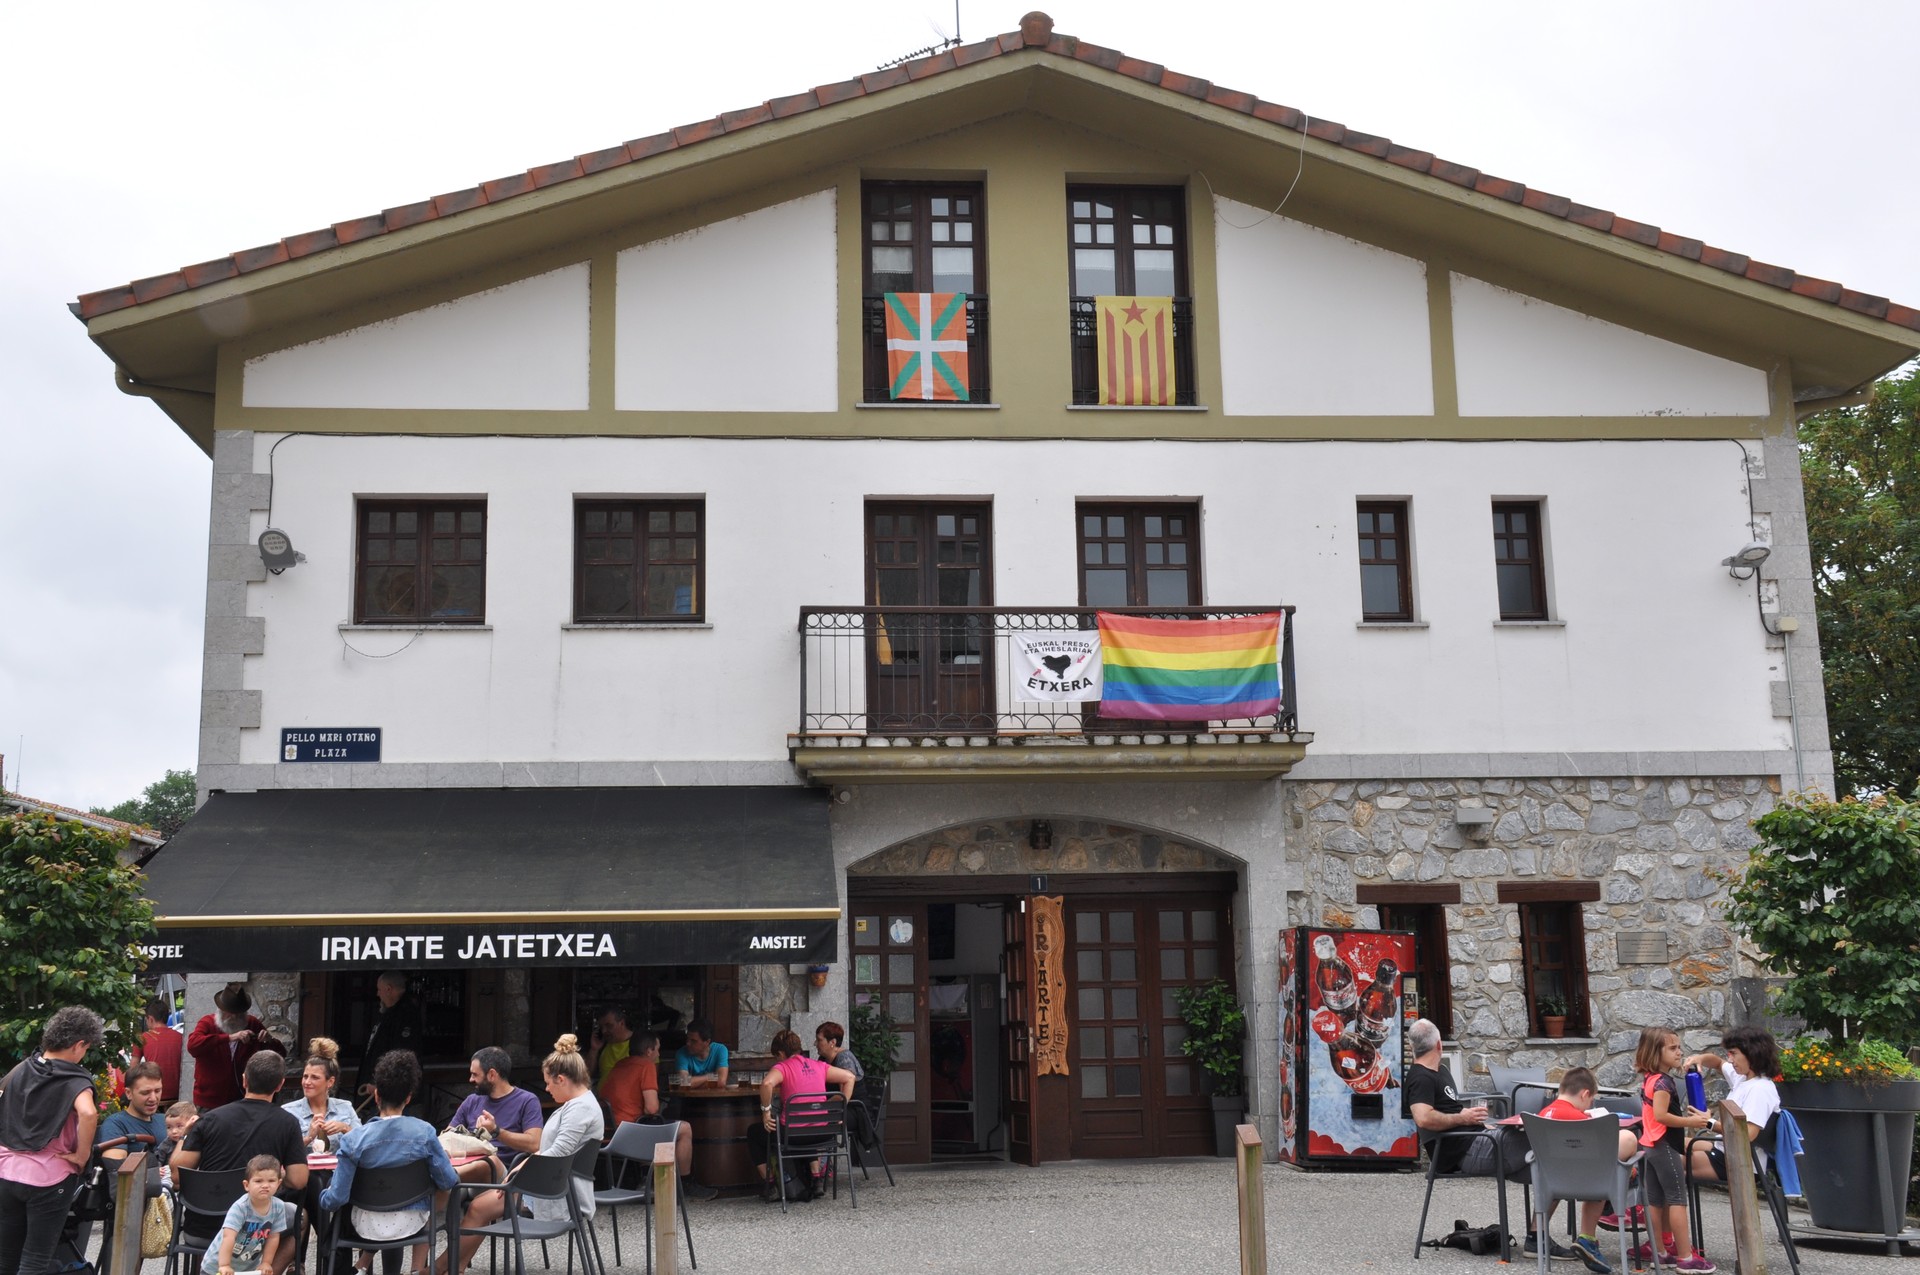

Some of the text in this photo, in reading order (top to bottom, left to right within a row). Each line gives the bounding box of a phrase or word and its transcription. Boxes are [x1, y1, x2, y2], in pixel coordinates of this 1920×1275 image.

[1026, 640, 1090, 649] EUSKAL PRESO
[1041, 646, 1093, 655] IHESLARIAK
[1027, 677, 1093, 692] ETXERA
[286, 733, 316, 742] PELLO
[314, 748, 347, 758] PLAZA
[1036, 877, 1042, 890] 1
[321, 933, 617, 961] IRIARTE JATETXEA
[749, 936, 806, 949] AMSTEL
